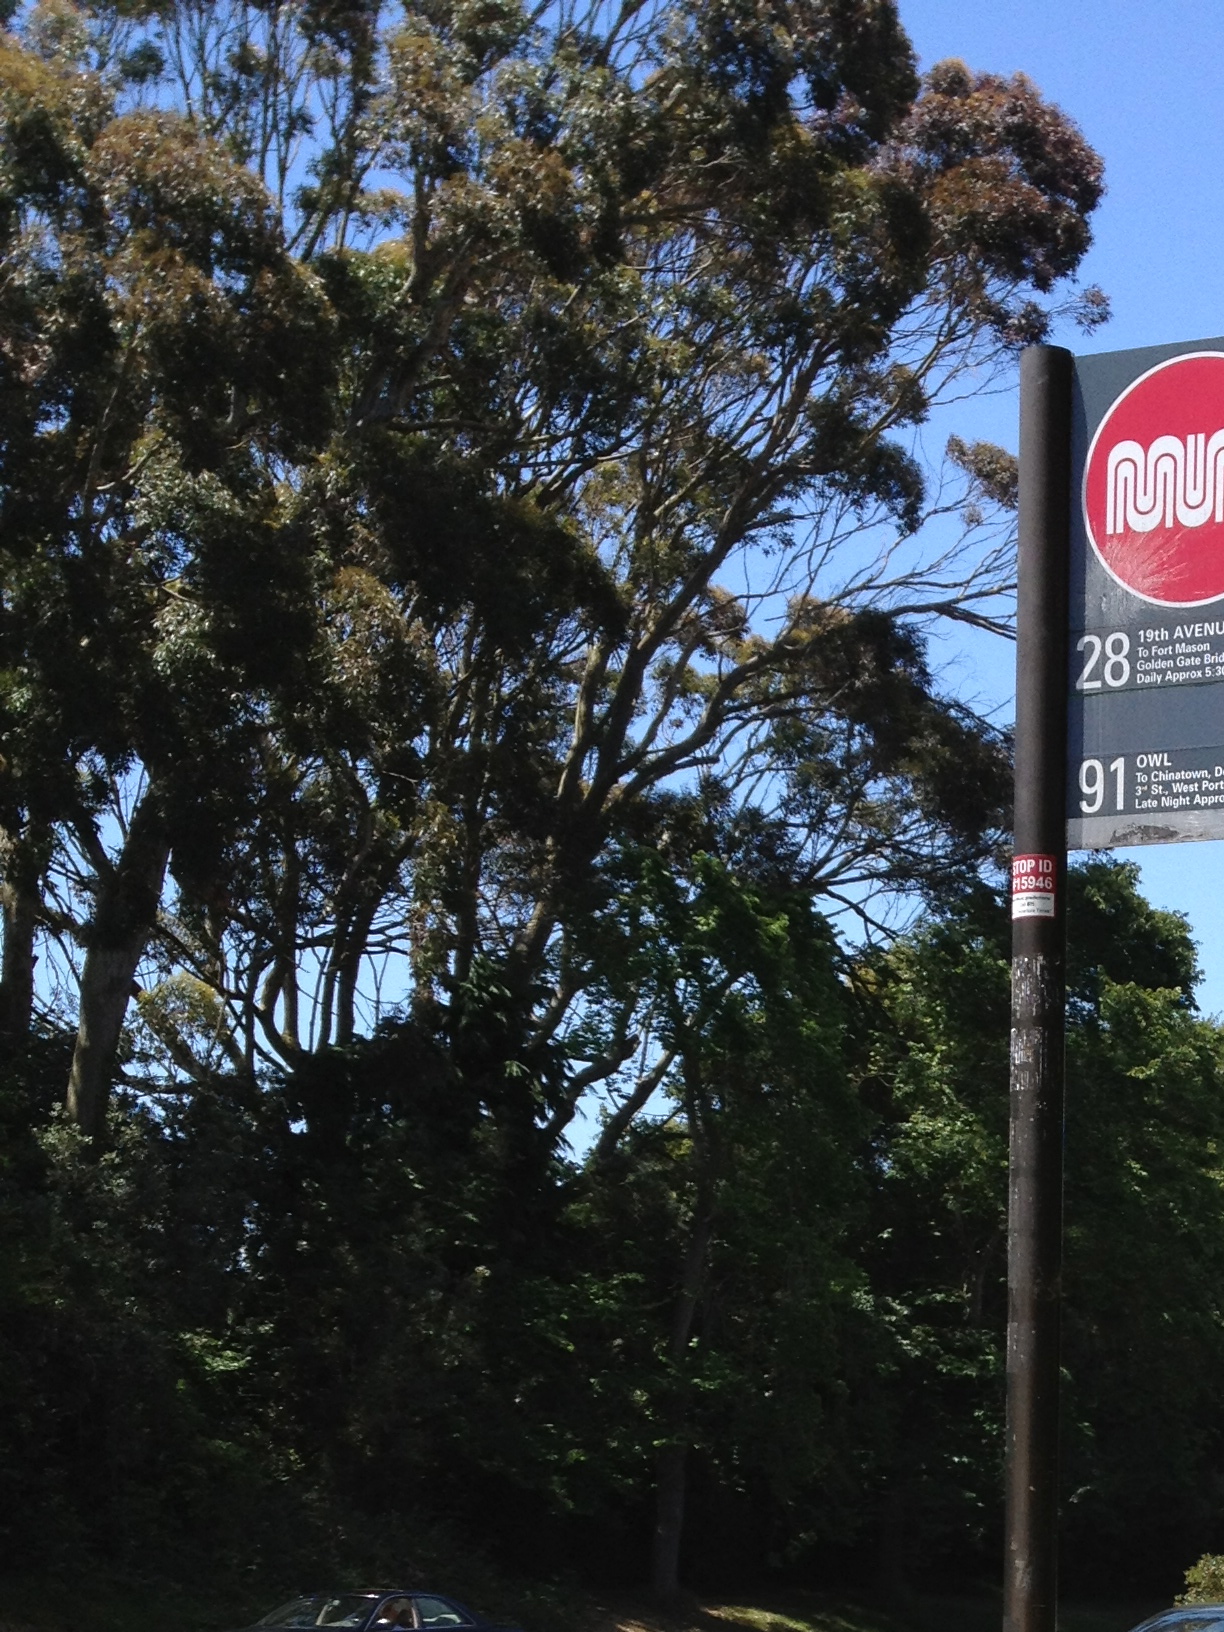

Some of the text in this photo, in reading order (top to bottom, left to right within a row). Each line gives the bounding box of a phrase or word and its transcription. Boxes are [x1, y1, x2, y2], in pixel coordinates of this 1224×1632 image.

[1139, 629, 1168, 642] 19th
[1138, 643, 1210, 657] To Fort Mason
[1076, 632, 1130, 690] 28
[1137, 659, 1173, 670] Golden
[1177, 656, 1201, 665] Gate
[1137, 672, 1162, 684] Daily
[1165, 670, 1202, 682] Approx
[1137, 753, 1171, 768] OWL
[1136, 773, 1147, 782] To
[1151, 770, 1211, 783] Chinatown,
[1080, 757, 1124, 813] 91
[1172, 782, 1198, 793] West
[1136, 799, 1157, 808] Late
[1162, 796, 1190, 808] Night
[1013, 859, 1052, 876] STOP ID
